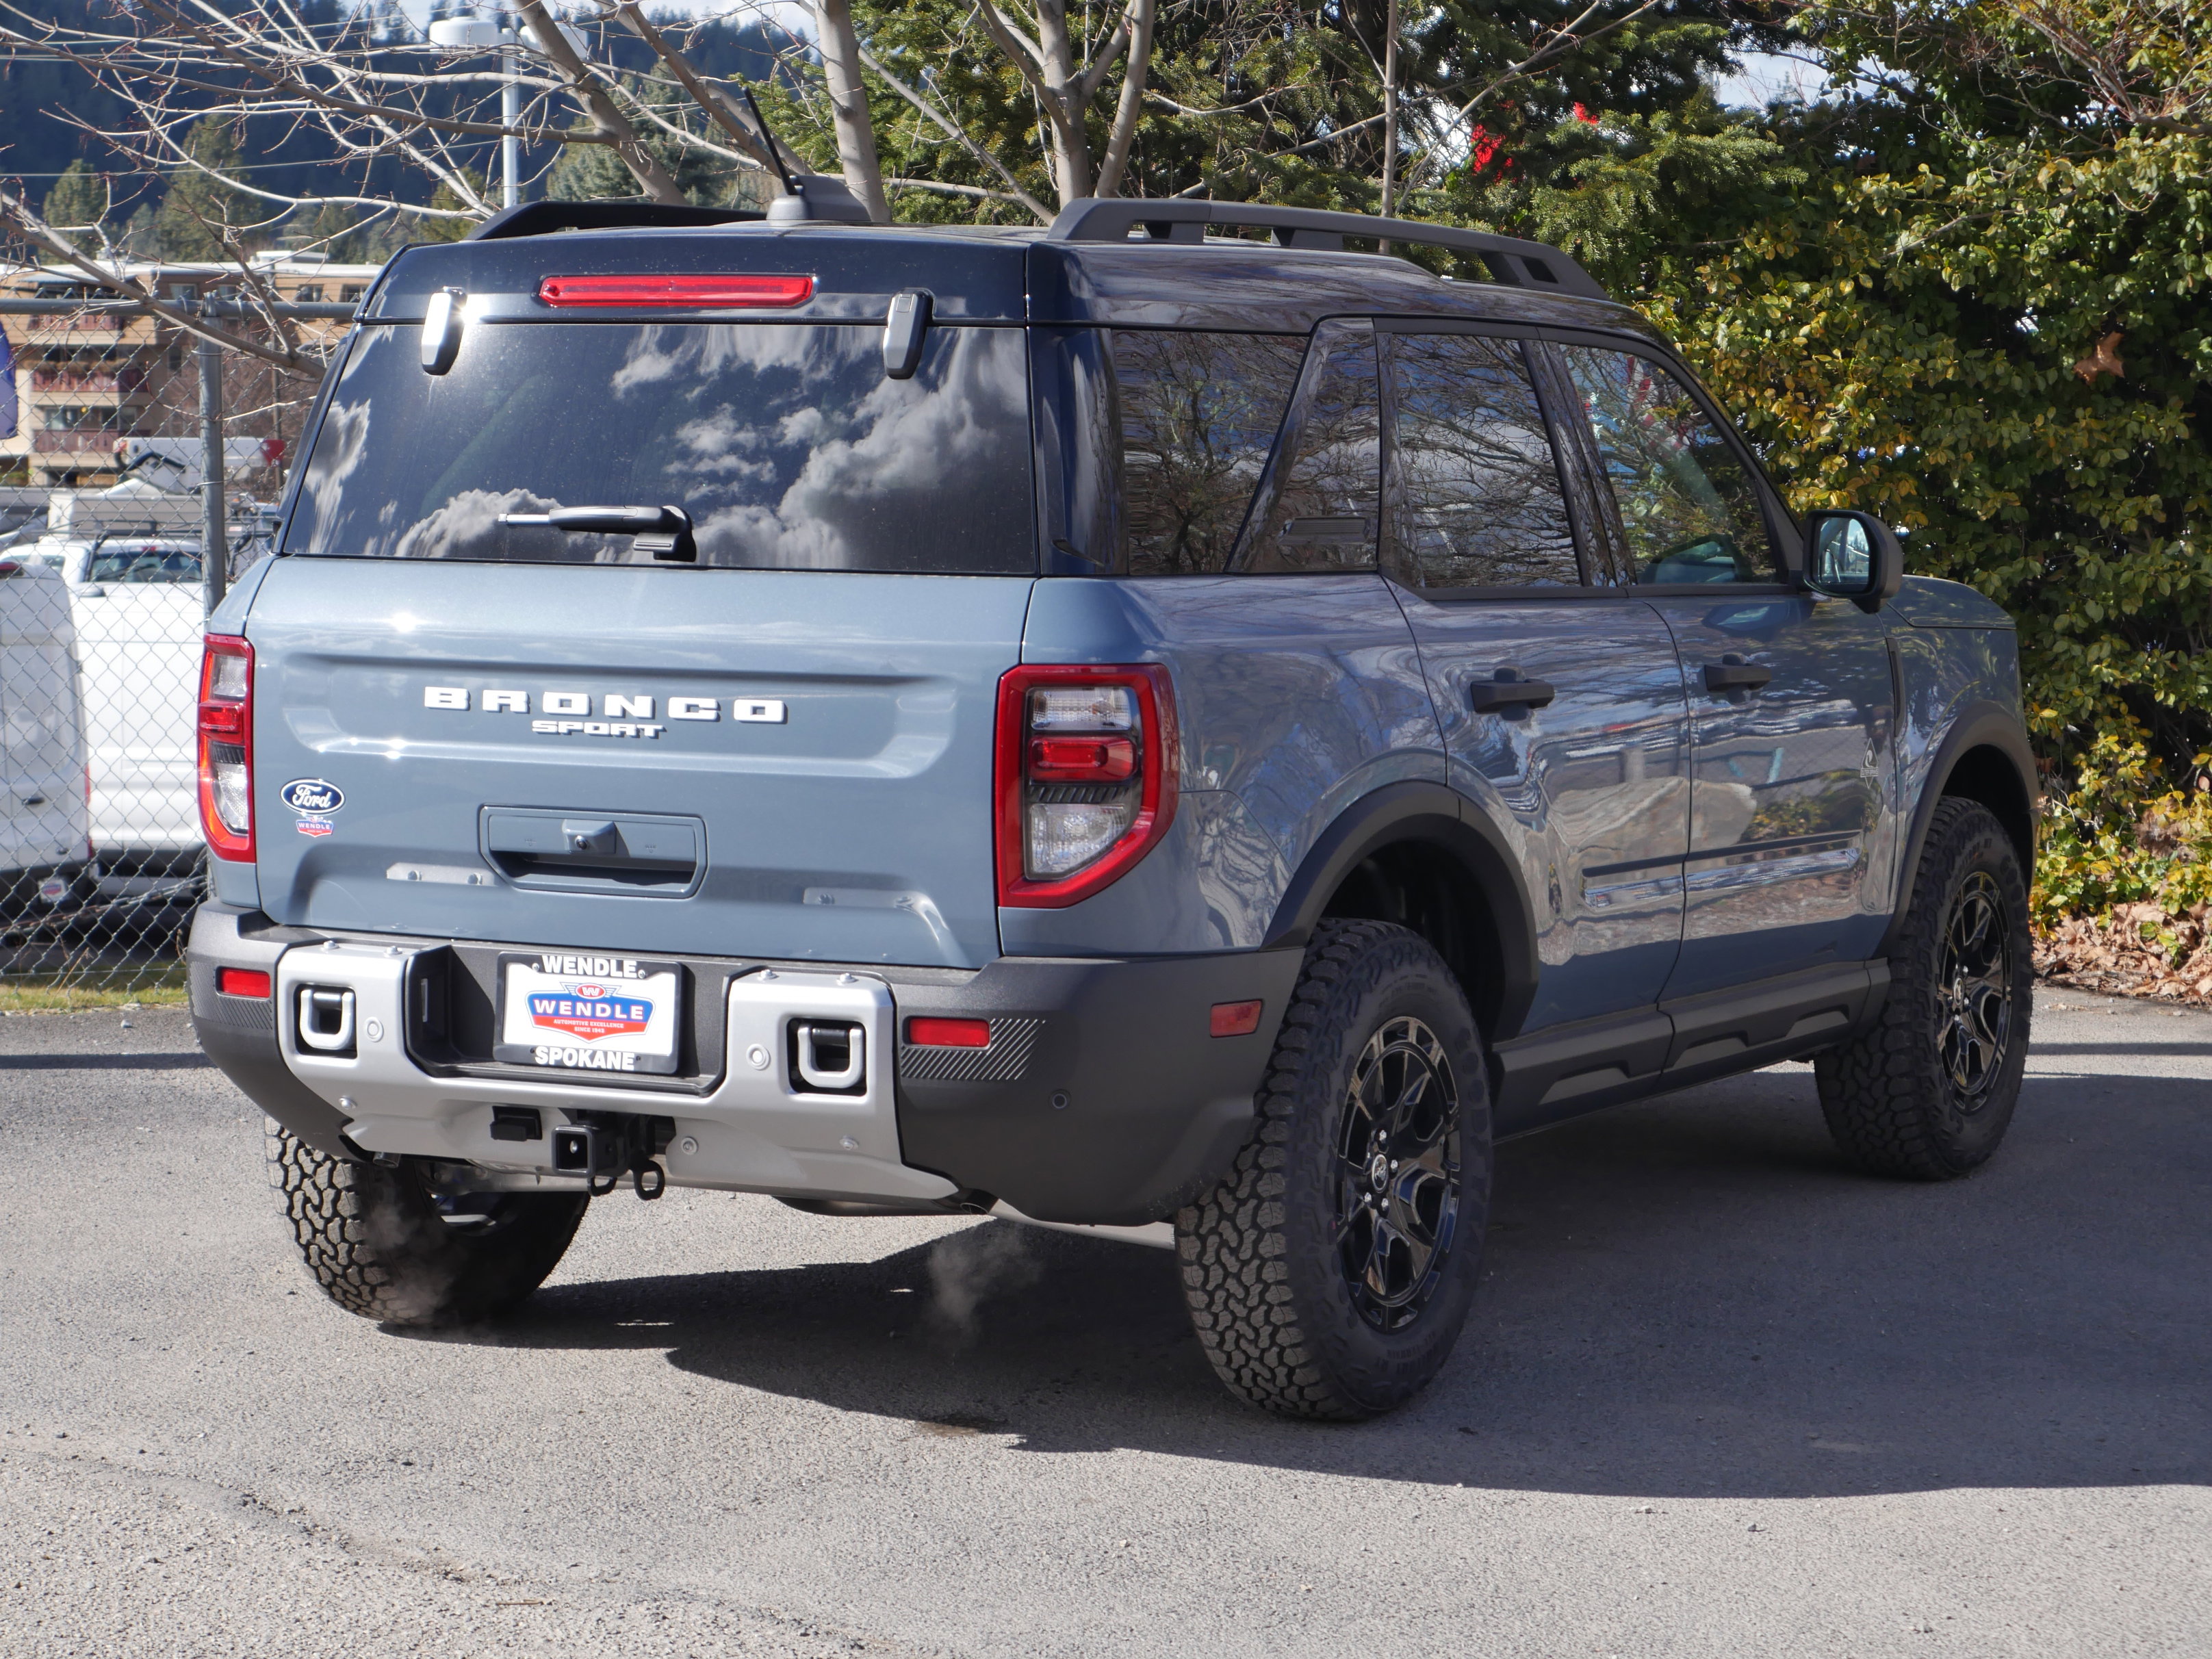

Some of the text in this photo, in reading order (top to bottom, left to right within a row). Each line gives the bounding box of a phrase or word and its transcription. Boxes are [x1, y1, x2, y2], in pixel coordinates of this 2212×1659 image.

[424, 686, 786, 723] BRONCO
[532, 720, 665, 737] SPORT
[292, 784, 332, 808] Ford
[541, 955, 637, 979] WENDLE
[533, 999, 644, 1020] WENDLE
[535, 1046, 635, 1070] SPOKANE
